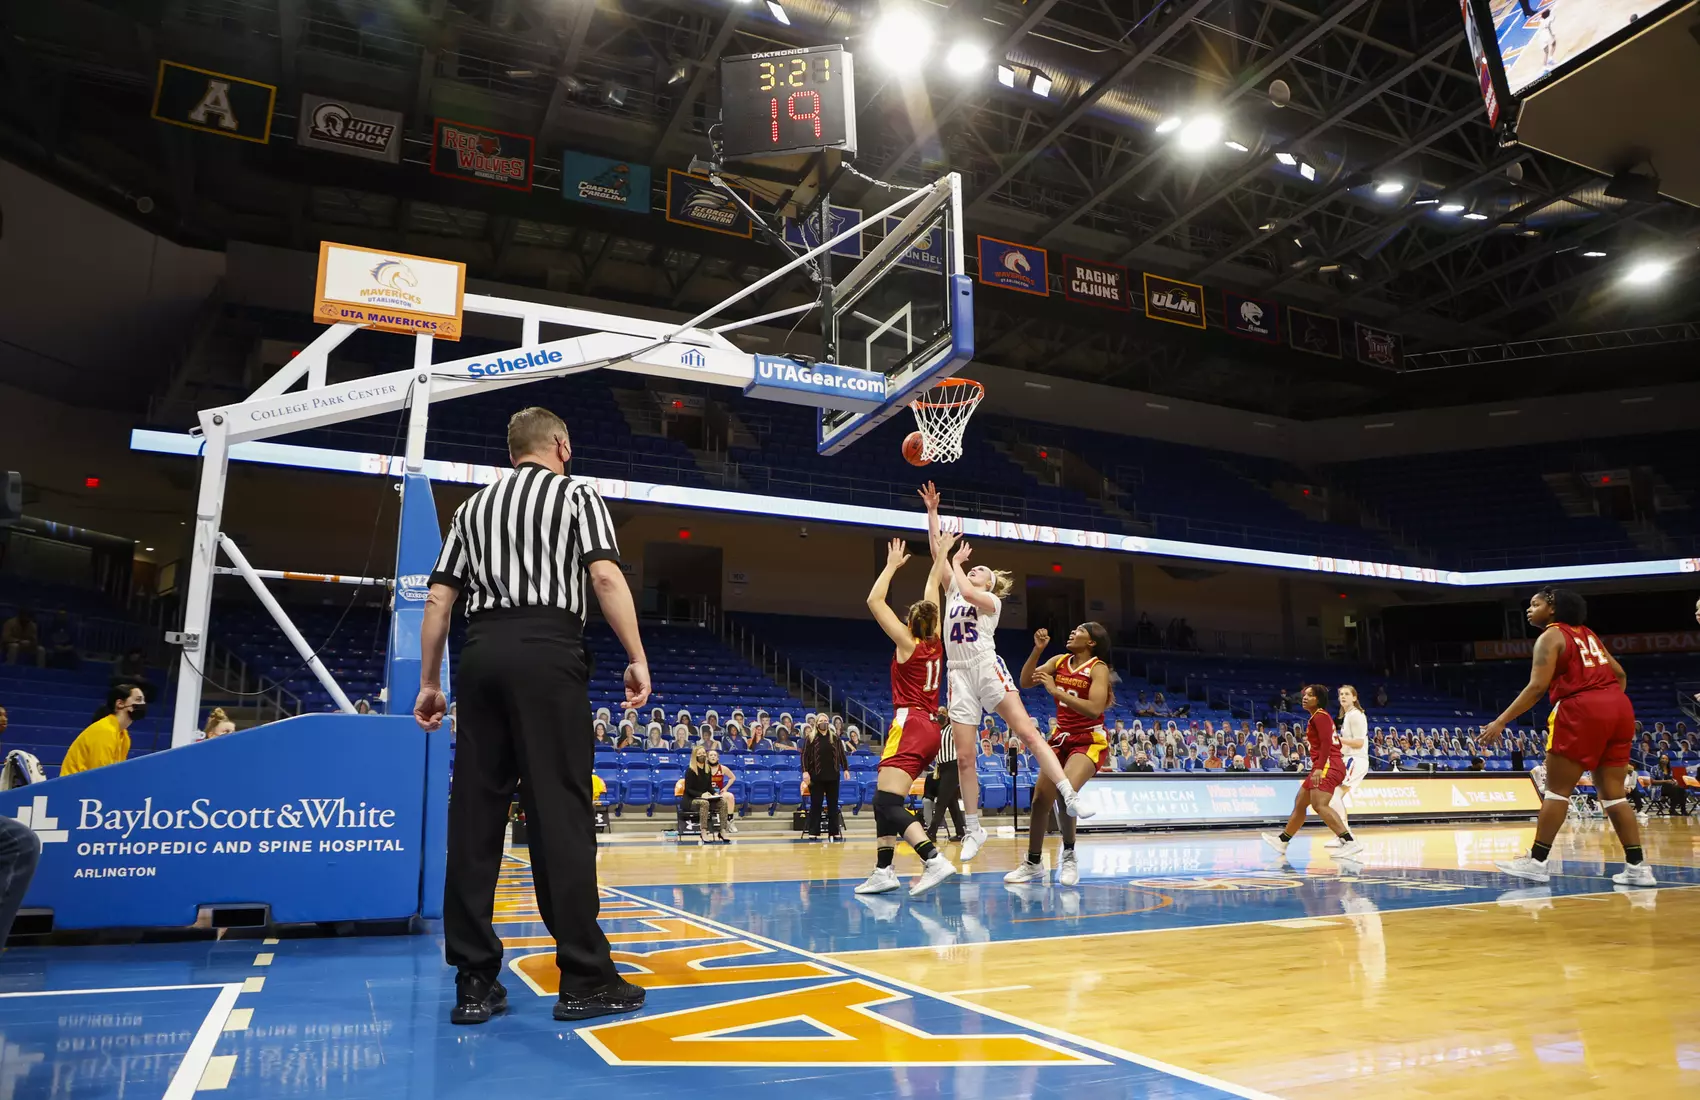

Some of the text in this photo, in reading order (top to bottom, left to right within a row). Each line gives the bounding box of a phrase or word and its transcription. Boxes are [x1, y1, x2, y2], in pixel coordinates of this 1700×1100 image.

[752, 48, 809, 59] DAKTRONICS
[760, 59, 830, 90] 3:21
[188, 79, 238, 131] A
[771, 91, 821, 141] 19
[347, 116, 392, 137] LITTLE
[343, 130, 387, 146] ROCK
[443, 127, 477, 150] RED
[457, 150, 526, 180] WOLVES
[578, 181, 619, 195] COASTAL
[579, 189, 627, 202] CAROLINA
[690, 211, 733, 225] SOUTHERN
[694, 205, 735, 219] GEORGIA
[921, 252, 943, 265] BEL
[360, 289, 421, 304] MAVERICKS
[1072, 280, 1120, 300] CAJUNS
[341, 309, 437, 328] UTA MAVERICKS
[467, 350, 563, 379] Schelde
[759, 361, 885, 394] UTAGear.com
[250, 384, 396, 422] COLLEGE PARK CENTER
[400, 574, 430, 589] FUZZ
[950, 605, 978, 621] UTA
[950, 622, 979, 644] 45
[1574, 635, 1609, 668] 24
[923, 659, 941, 692] 11
[1132, 790, 1195, 801] AMERICAN
[1133, 803, 1200, 814] CAMPUS
[77, 839, 404, 856] ORTHOPEDIC AND SPINE HOSPITAL
[74, 867, 157, 878] ARLINGTON
